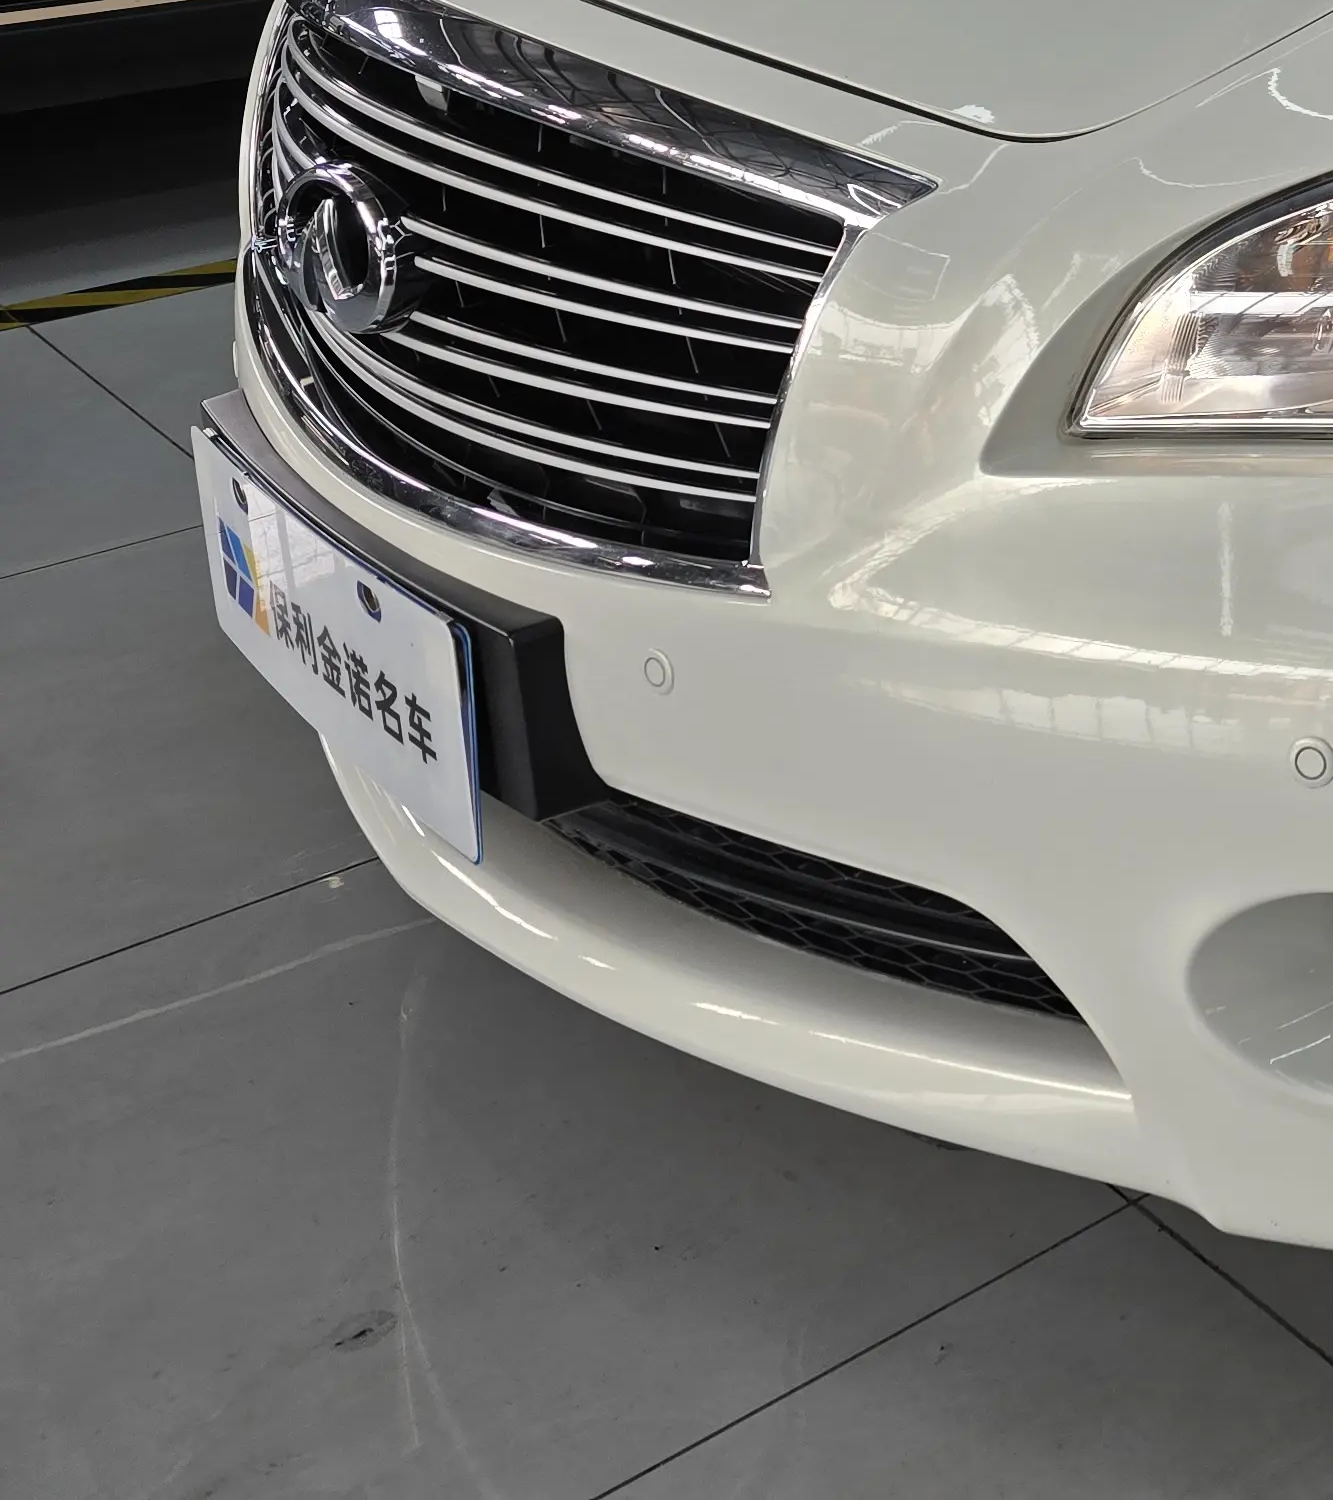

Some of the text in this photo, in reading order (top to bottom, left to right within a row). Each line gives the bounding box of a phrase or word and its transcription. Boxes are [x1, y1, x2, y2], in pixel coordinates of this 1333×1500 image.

[269, 580, 437, 764] 保利金诺名车
